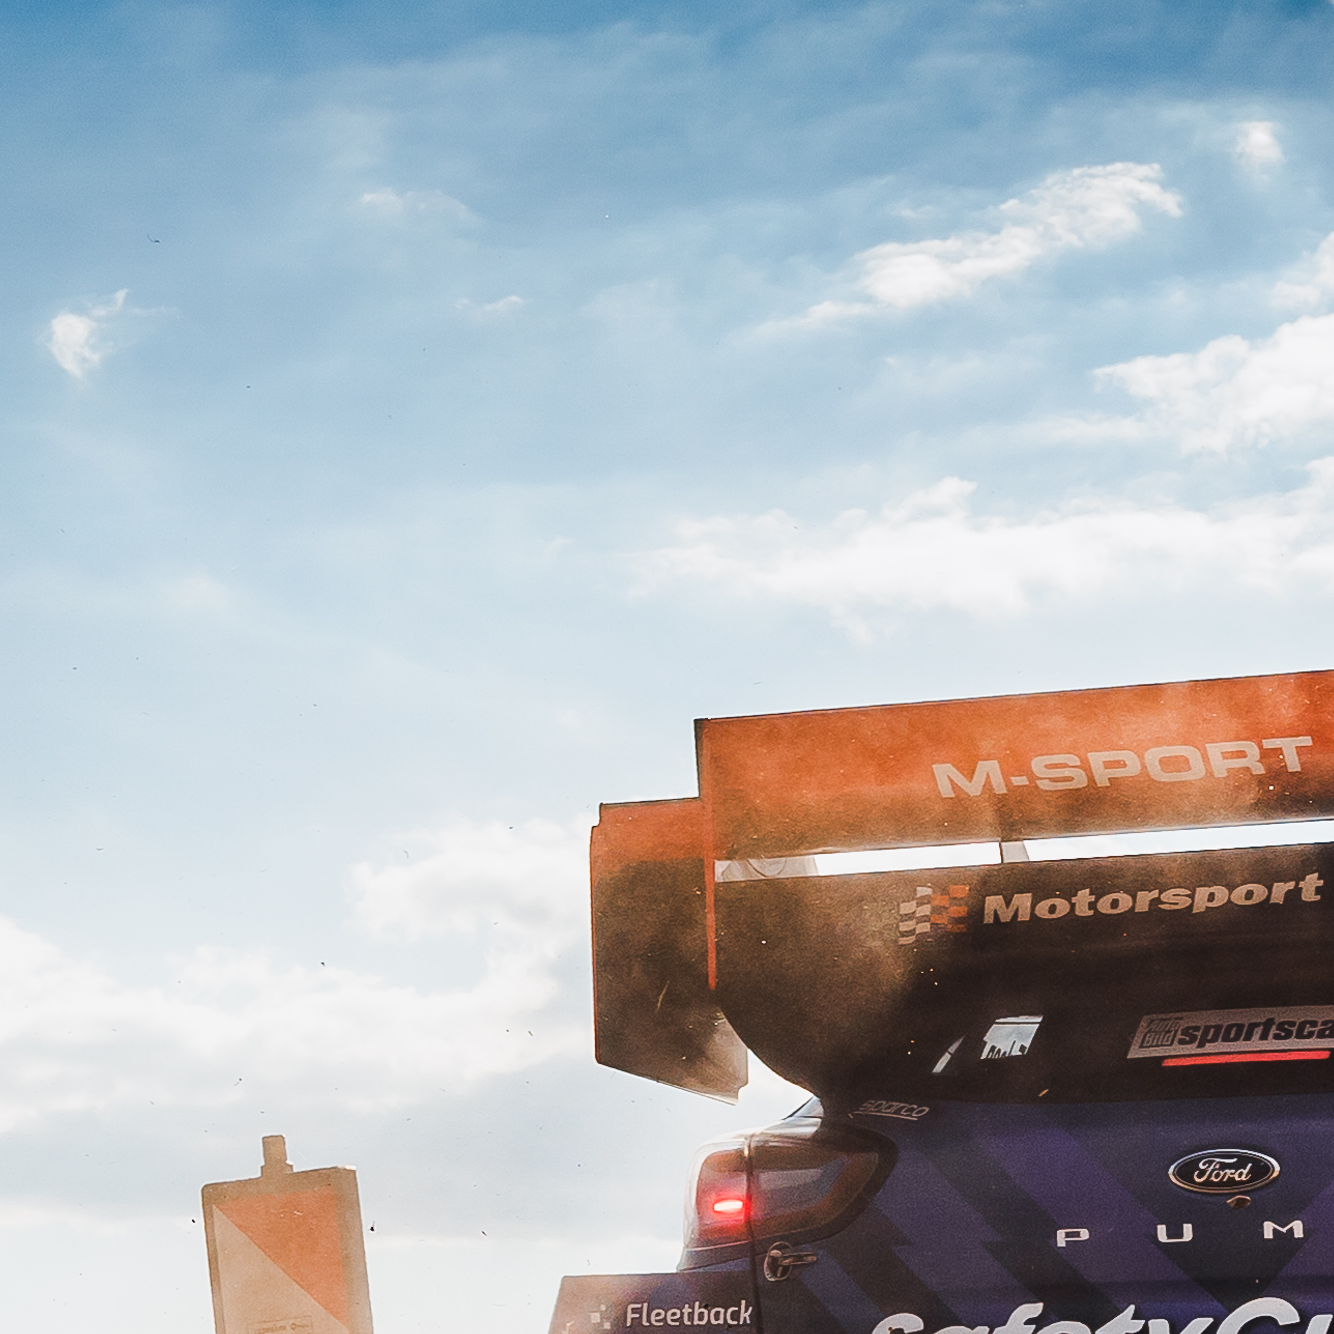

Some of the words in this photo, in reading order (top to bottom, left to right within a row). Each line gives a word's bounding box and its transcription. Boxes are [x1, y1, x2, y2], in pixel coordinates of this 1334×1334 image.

[932, 736, 1312, 798] M-SPORT
[983, 871, 1324, 924] Motorsport
[859, 1100, 930, 1117] sparco
[1193, 1157, 1252, 1182] Ford
[626, 1300, 753, 1327] Fleetback
